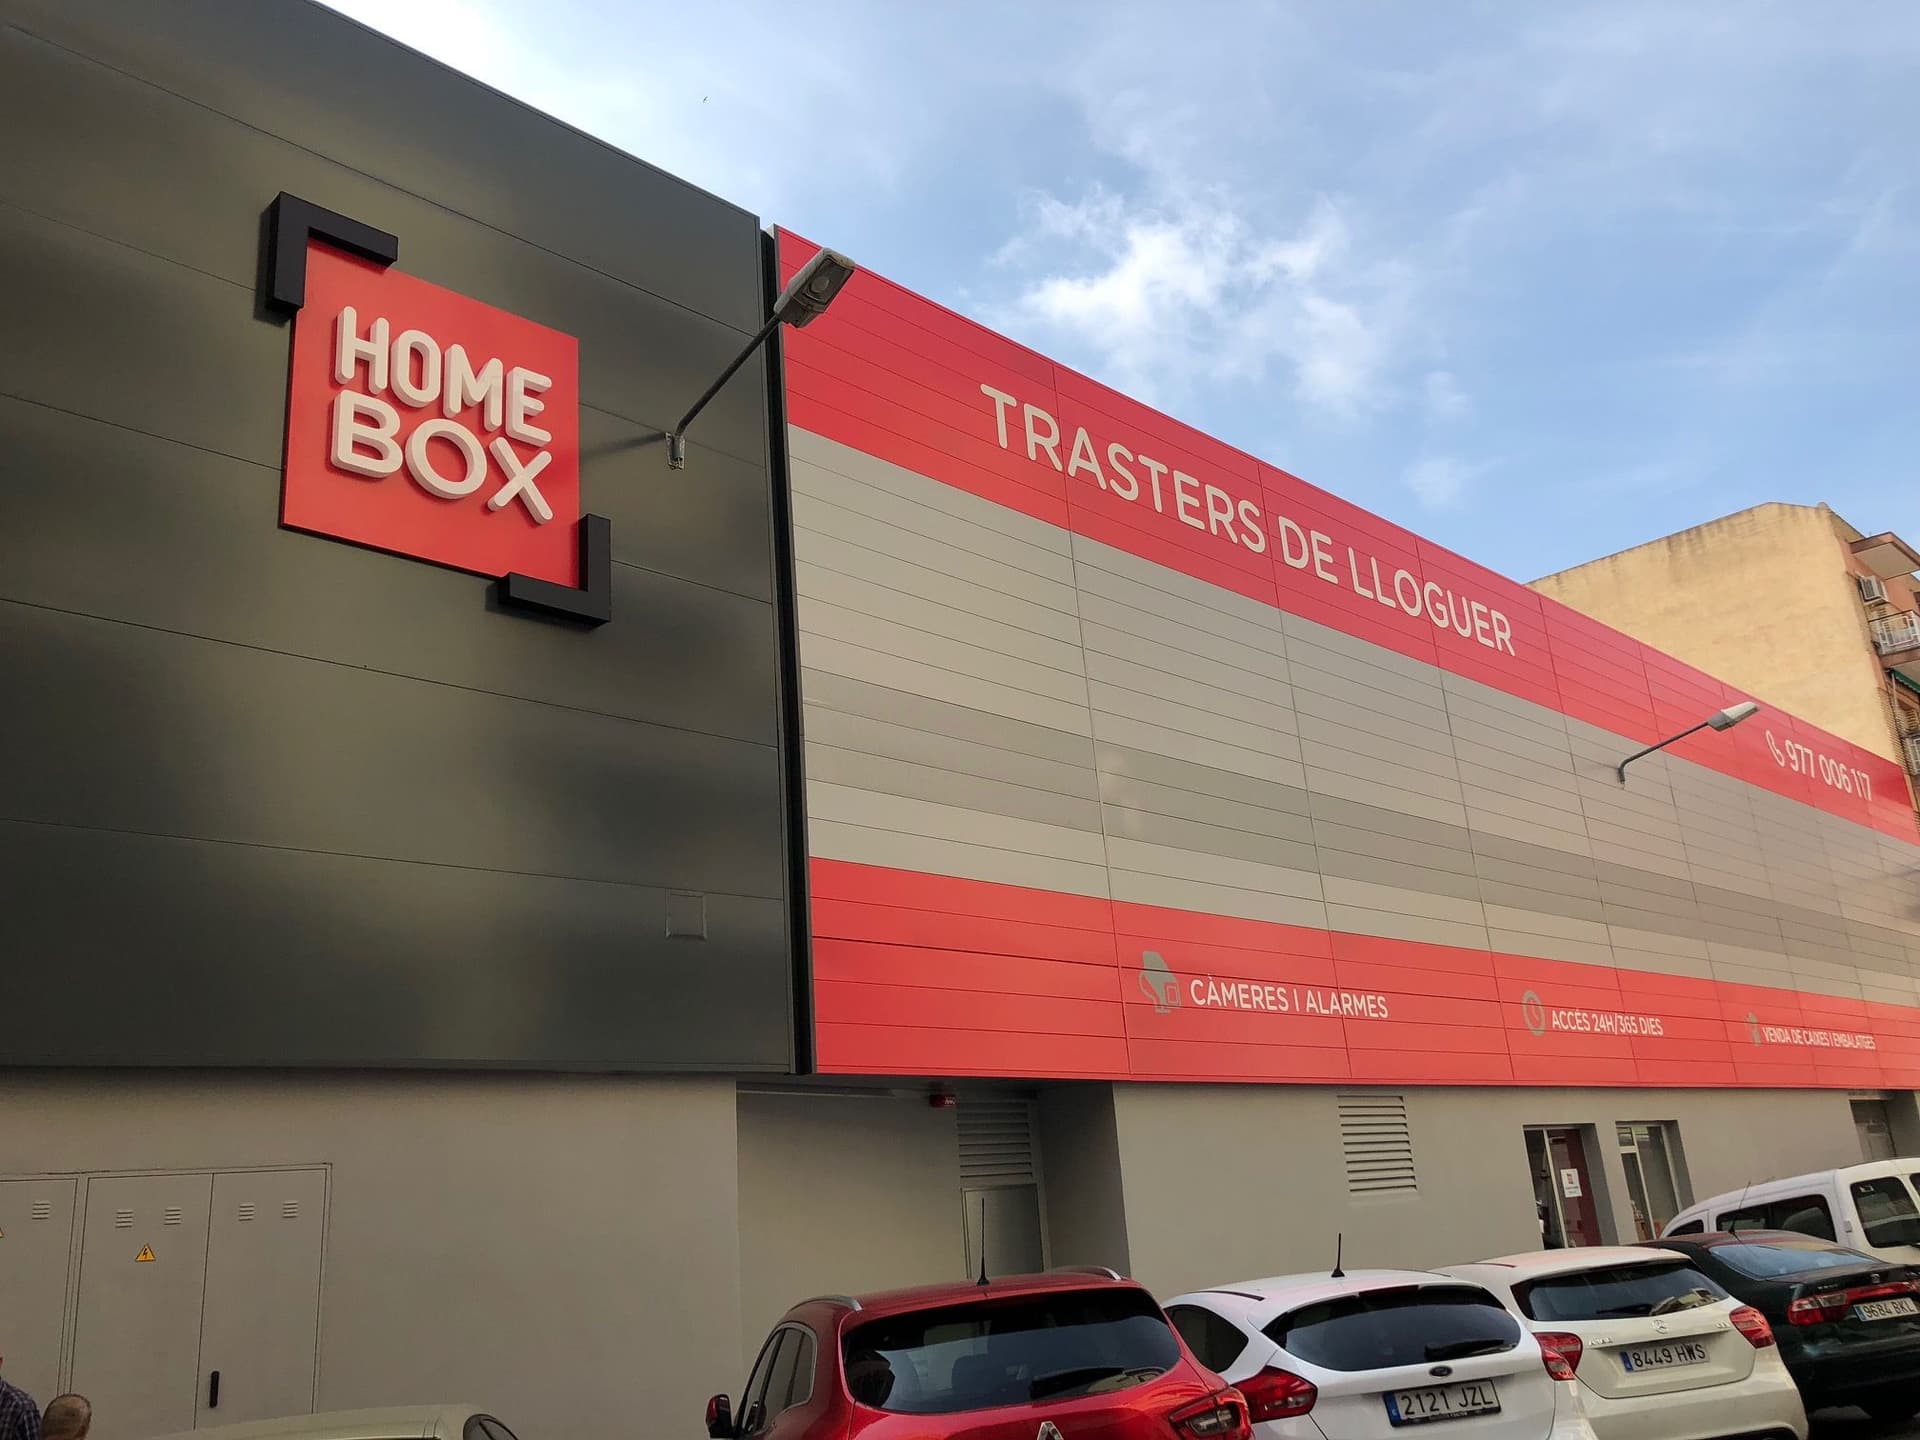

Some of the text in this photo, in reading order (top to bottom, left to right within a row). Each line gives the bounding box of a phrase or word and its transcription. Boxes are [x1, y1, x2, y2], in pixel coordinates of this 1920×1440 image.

[334, 306, 553, 447] HOME
[331, 389, 554, 525] BOX
[980, 383, 1516, 657] TRASTERS DE LLOGUER
[1785, 739, 1816, 779] 977
[1818, 754, 1852, 793] 006
[1190, 973, 1389, 1019] CÀMERES I ALARMES
[1591, 1012, 1638, 1036] 24H/365
[1638, 1016, 1664, 1036] DIES
[1762, 1026, 1792, 1044] VENDA
[1790, 1028, 1804, 1045] DE
[1632, 1343, 1706, 1368] 8449 HWS
[1401, 1385, 1494, 1416] 2121 JZL
